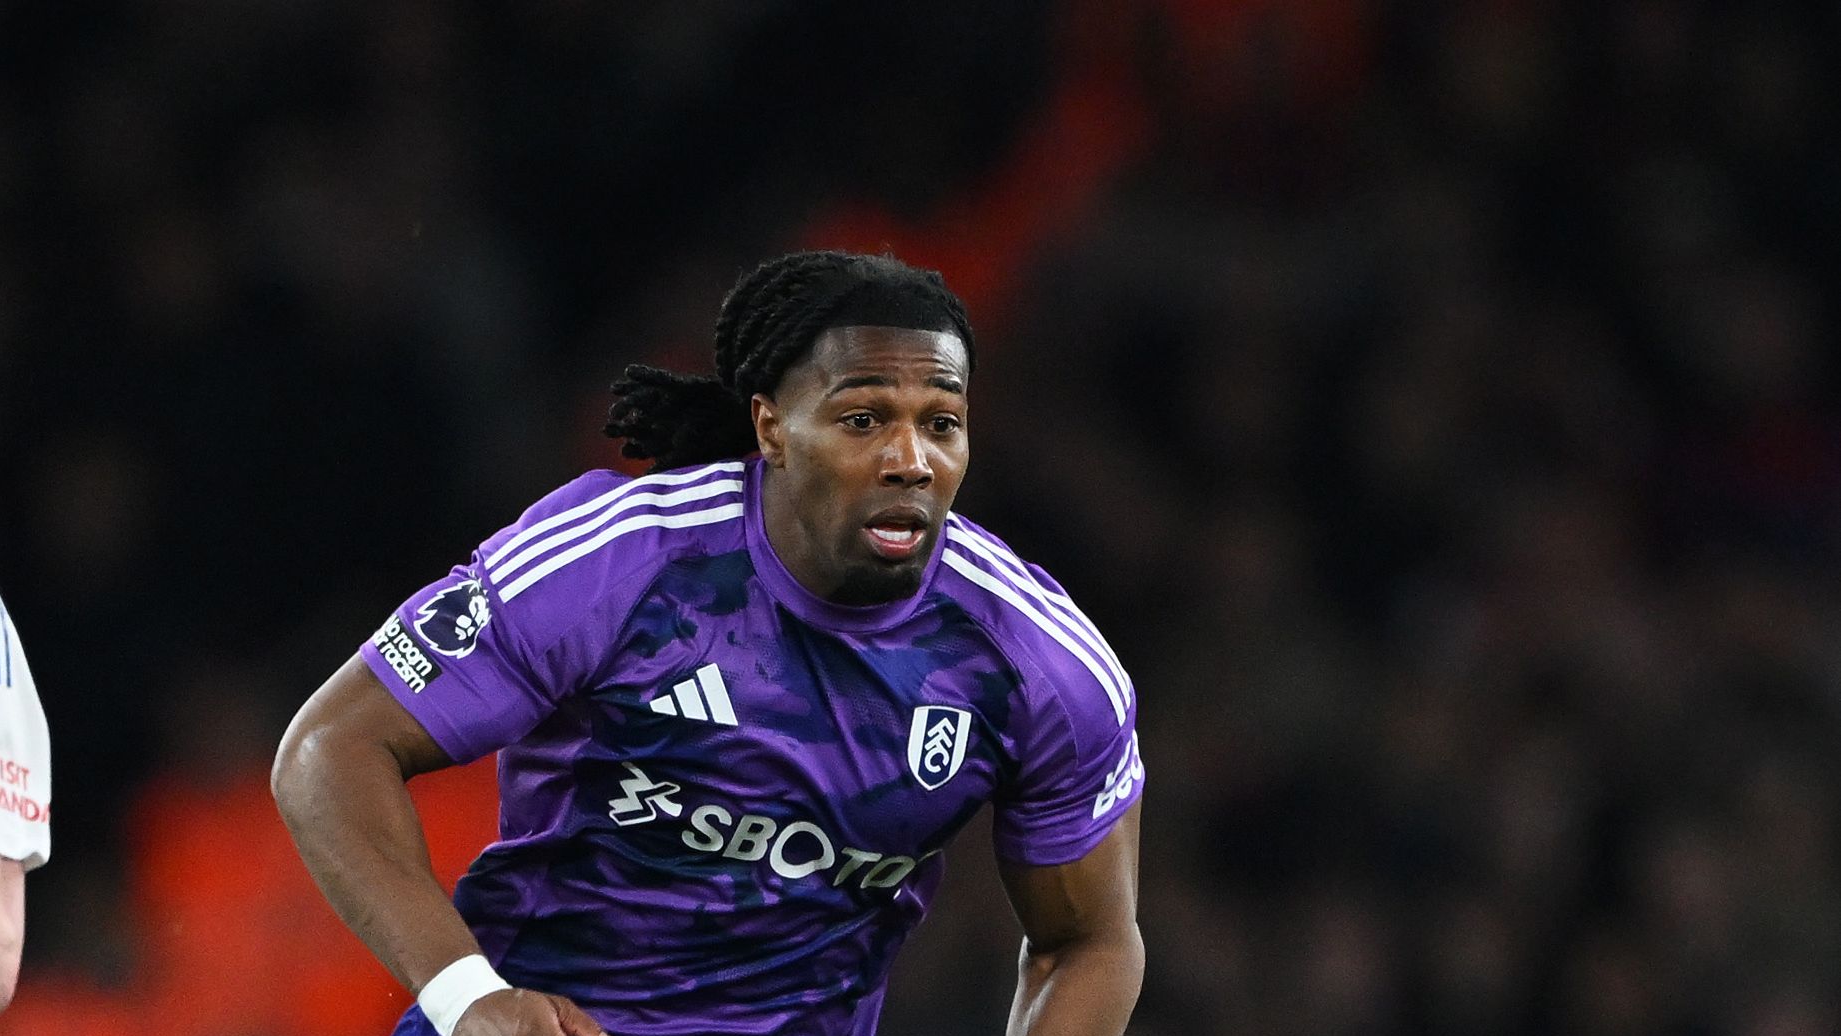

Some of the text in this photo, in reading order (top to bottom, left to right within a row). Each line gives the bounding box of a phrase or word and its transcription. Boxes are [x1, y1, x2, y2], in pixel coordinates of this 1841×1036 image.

[379, 642, 426, 694] racism
[392, 632, 433, 677] room
[924, 717, 956, 773] FFC
[681, 804, 945, 898] SBOTO
